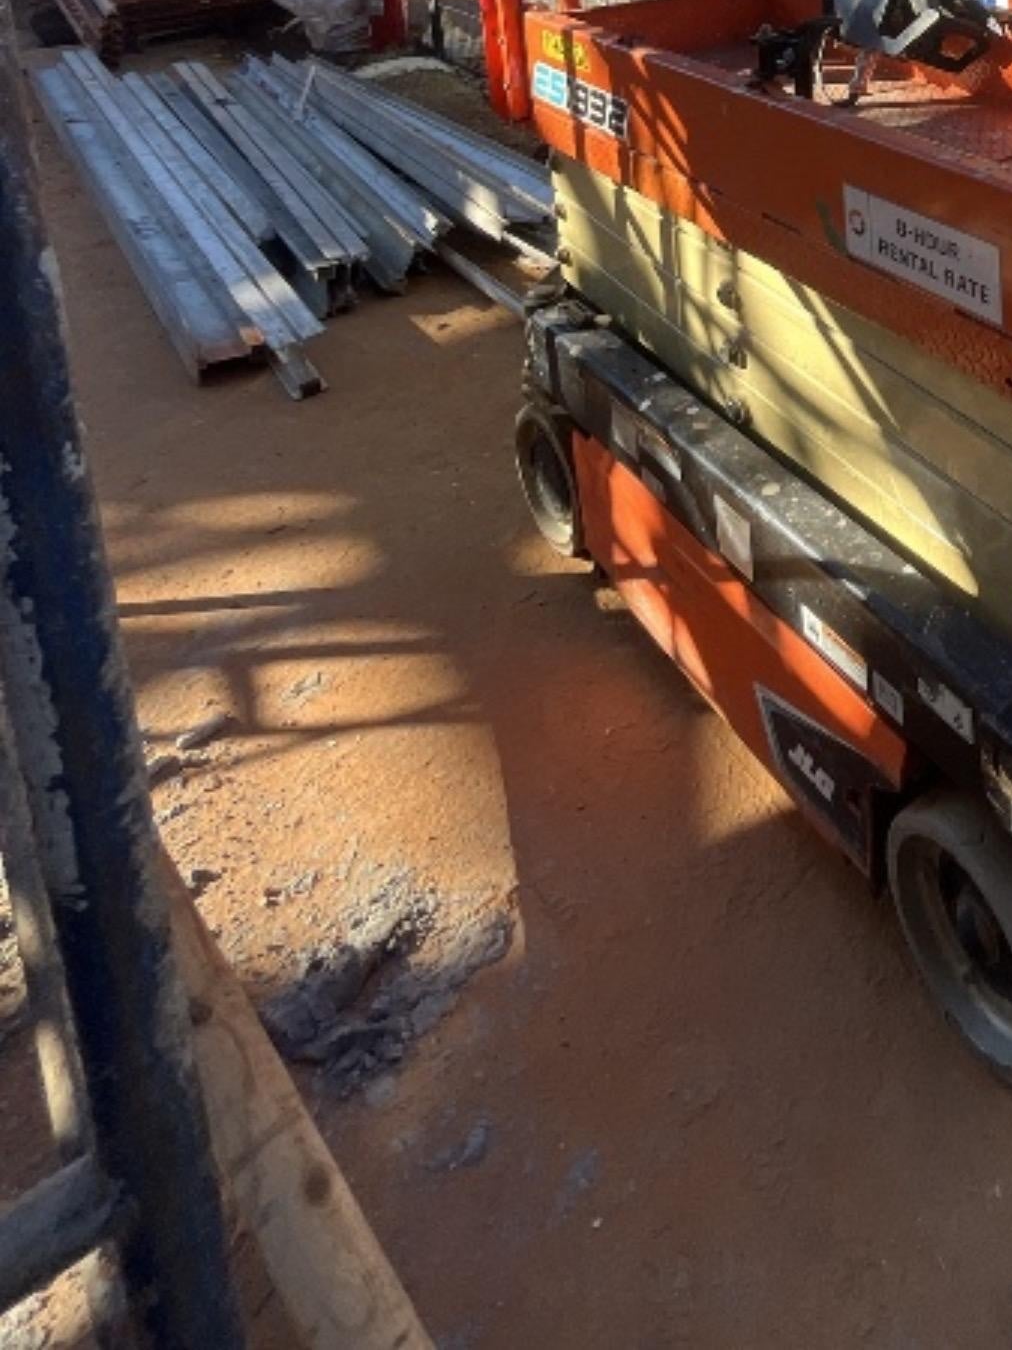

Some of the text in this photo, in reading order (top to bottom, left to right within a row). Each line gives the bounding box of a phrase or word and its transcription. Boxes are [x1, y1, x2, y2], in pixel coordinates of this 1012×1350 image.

[878, 236, 991, 305] RENTAL RATE
[787, 742, 835, 803] JLG
